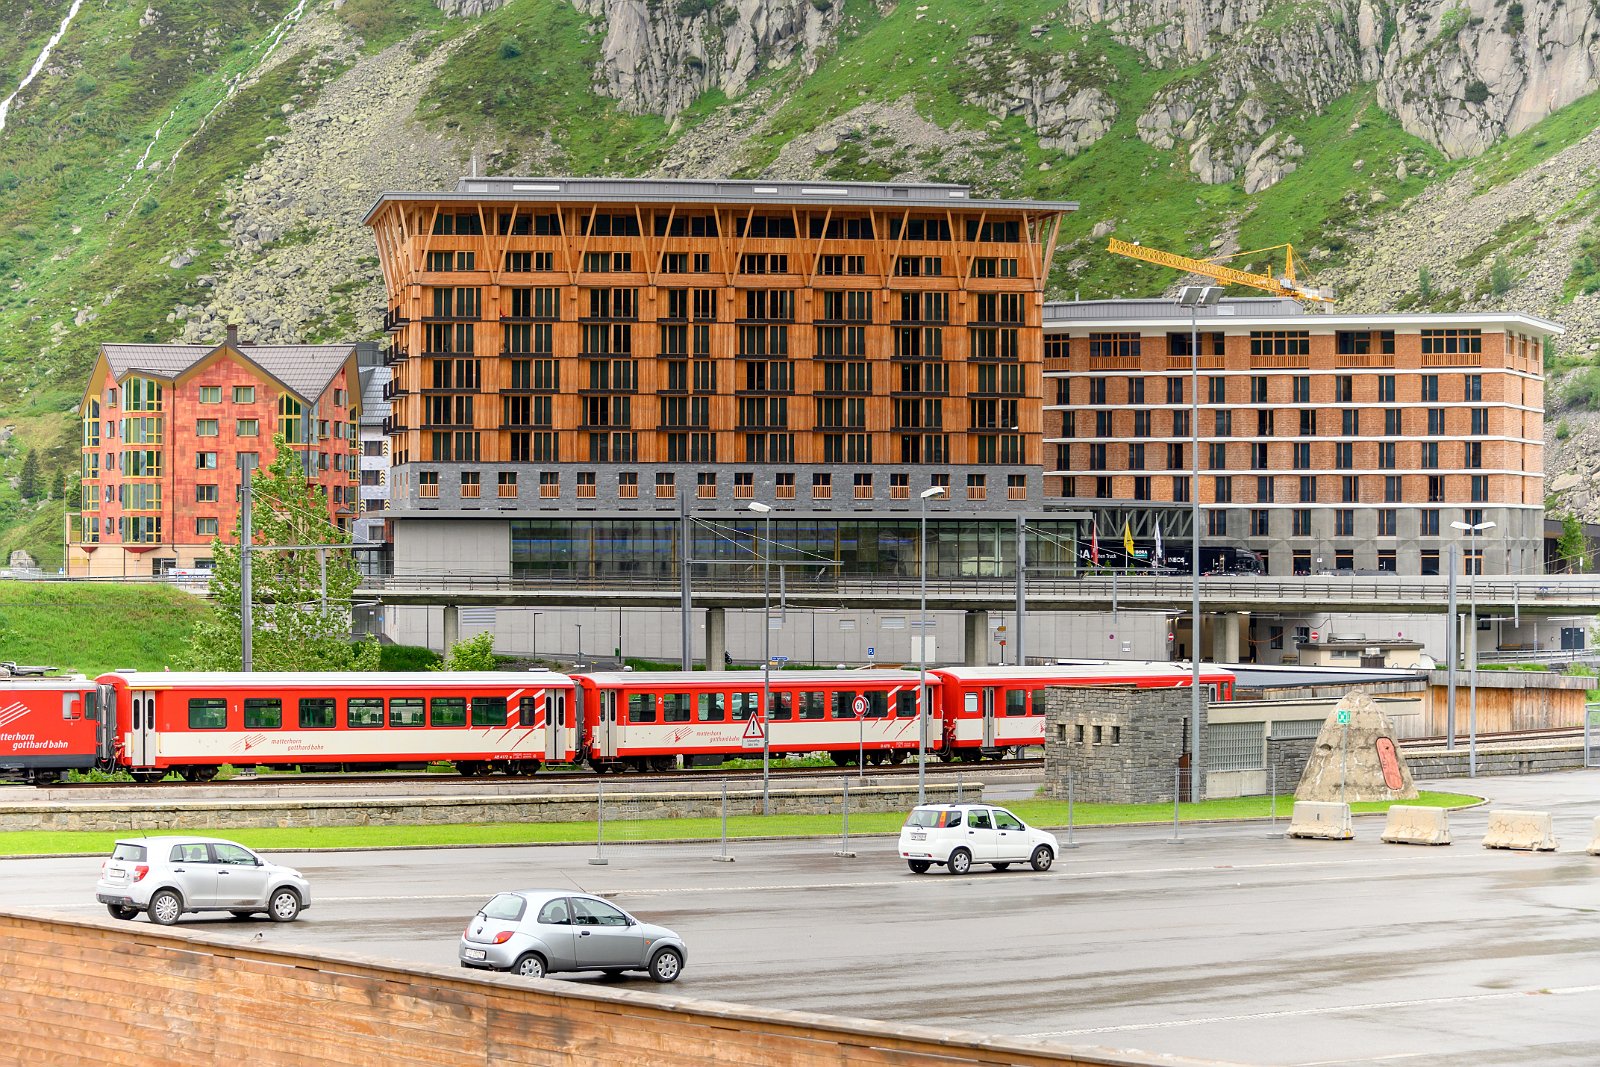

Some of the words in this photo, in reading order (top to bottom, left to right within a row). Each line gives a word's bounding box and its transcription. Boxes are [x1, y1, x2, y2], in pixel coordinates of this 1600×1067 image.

[1027, 691, 1032, 699] 2
[234, 704, 238, 712] 1
[466, 703, 472, 711] 2
[0, 732, 35, 741] tterhorn
[12, 740, 49, 751] gotthard
[49, 740, 68, 749] bahn
